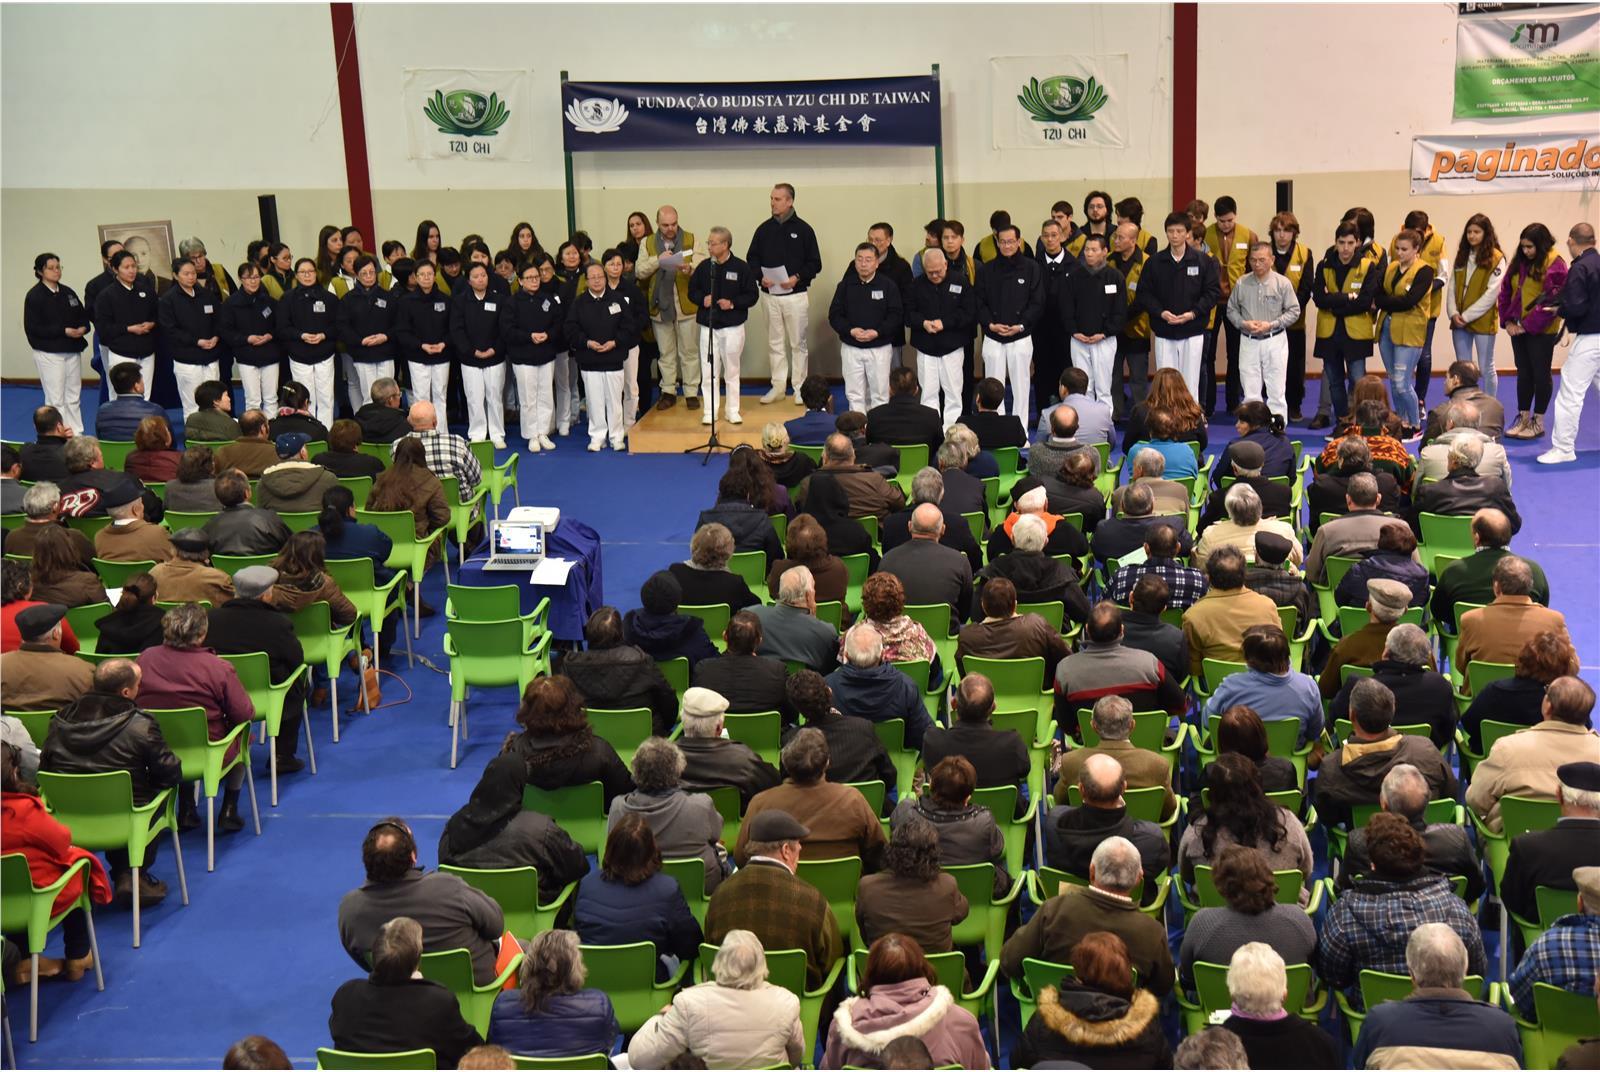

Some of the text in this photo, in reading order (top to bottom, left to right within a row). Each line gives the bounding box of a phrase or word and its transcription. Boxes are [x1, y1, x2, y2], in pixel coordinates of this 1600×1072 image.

[1492, 74, 1576, 86] ORÇAMENTOS GRATUITOS
[637, 91, 931, 110] FUNDAÇÃO BUDISTA TZU CHI DE TAIWAN
[1043, 128, 1087, 140] TZU CHI
[449, 140, 490, 154] TZU CHI
[1551, 170, 1590, 179] SOLUÇÕES
